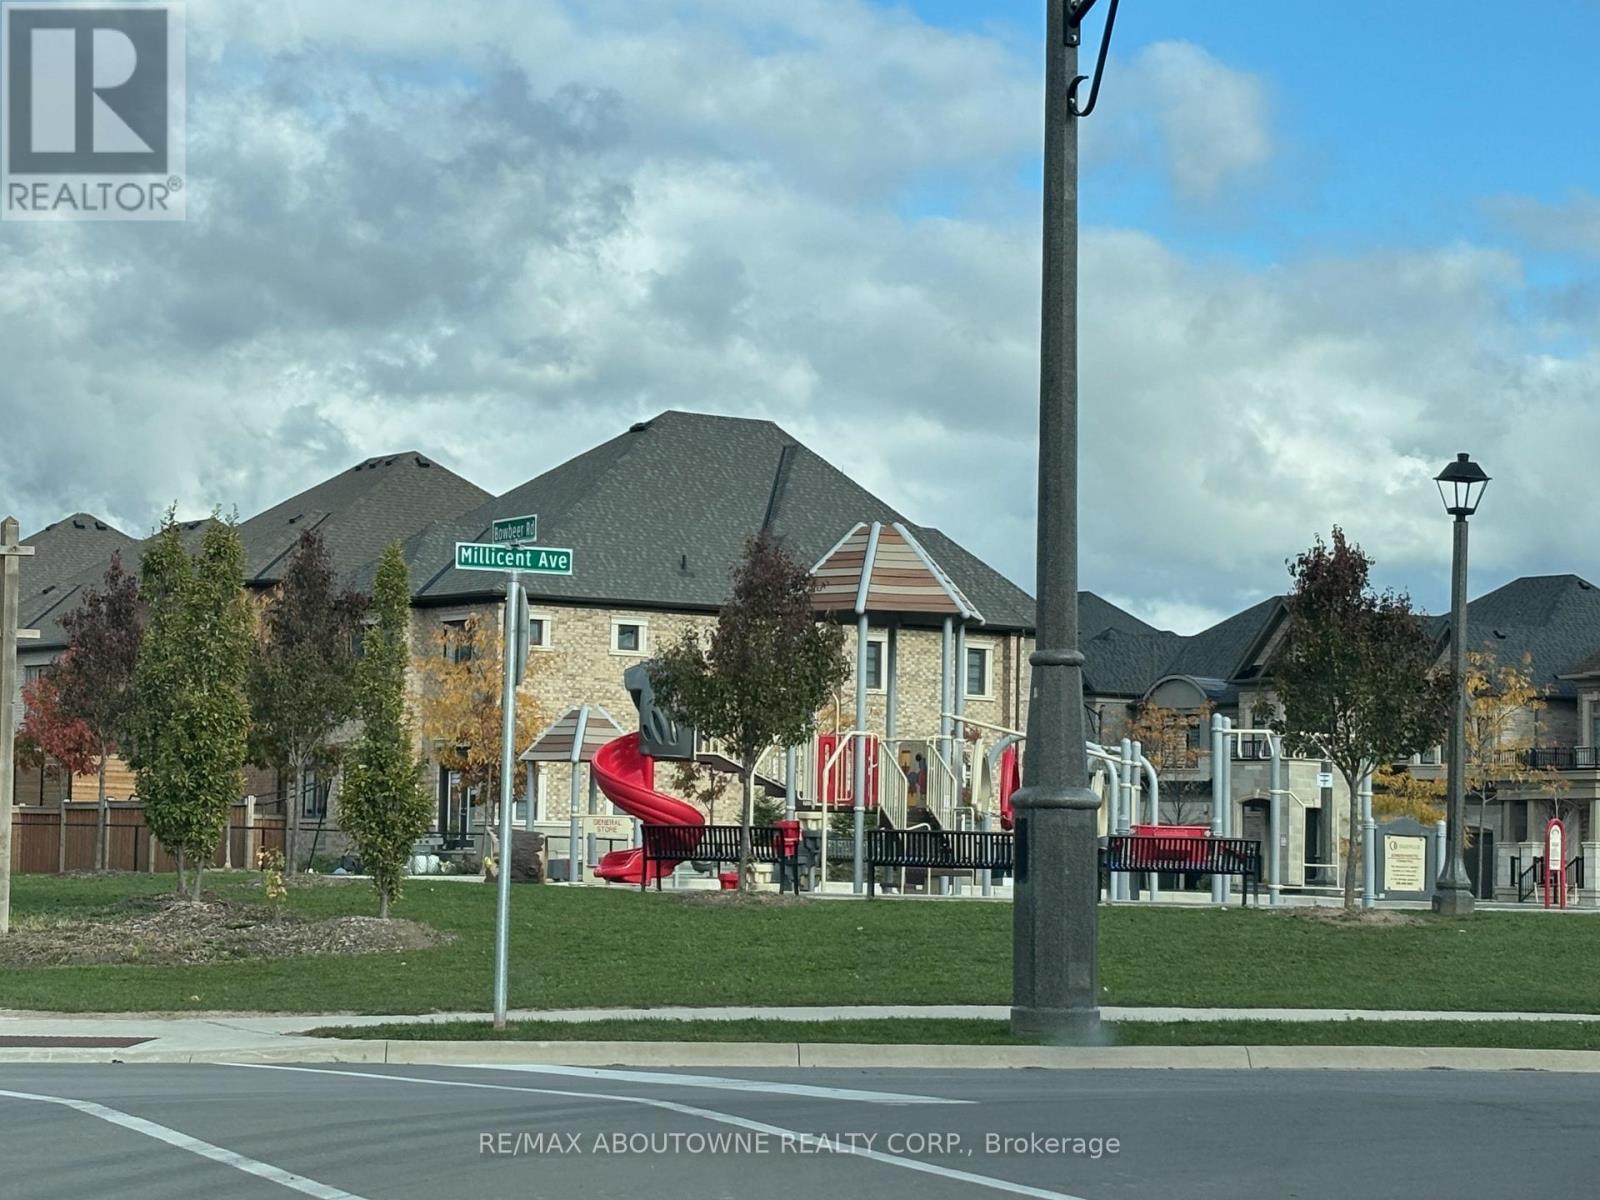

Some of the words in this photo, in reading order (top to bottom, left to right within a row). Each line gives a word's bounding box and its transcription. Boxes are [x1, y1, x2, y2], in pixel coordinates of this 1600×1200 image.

[494, 523, 524, 541] Bowbeer
[526, 520, 535, 536] Rd
[461, 547, 532, 567] Millicent
[538, 551, 568, 569] Ave
[593, 818, 622, 826] GENERAL
